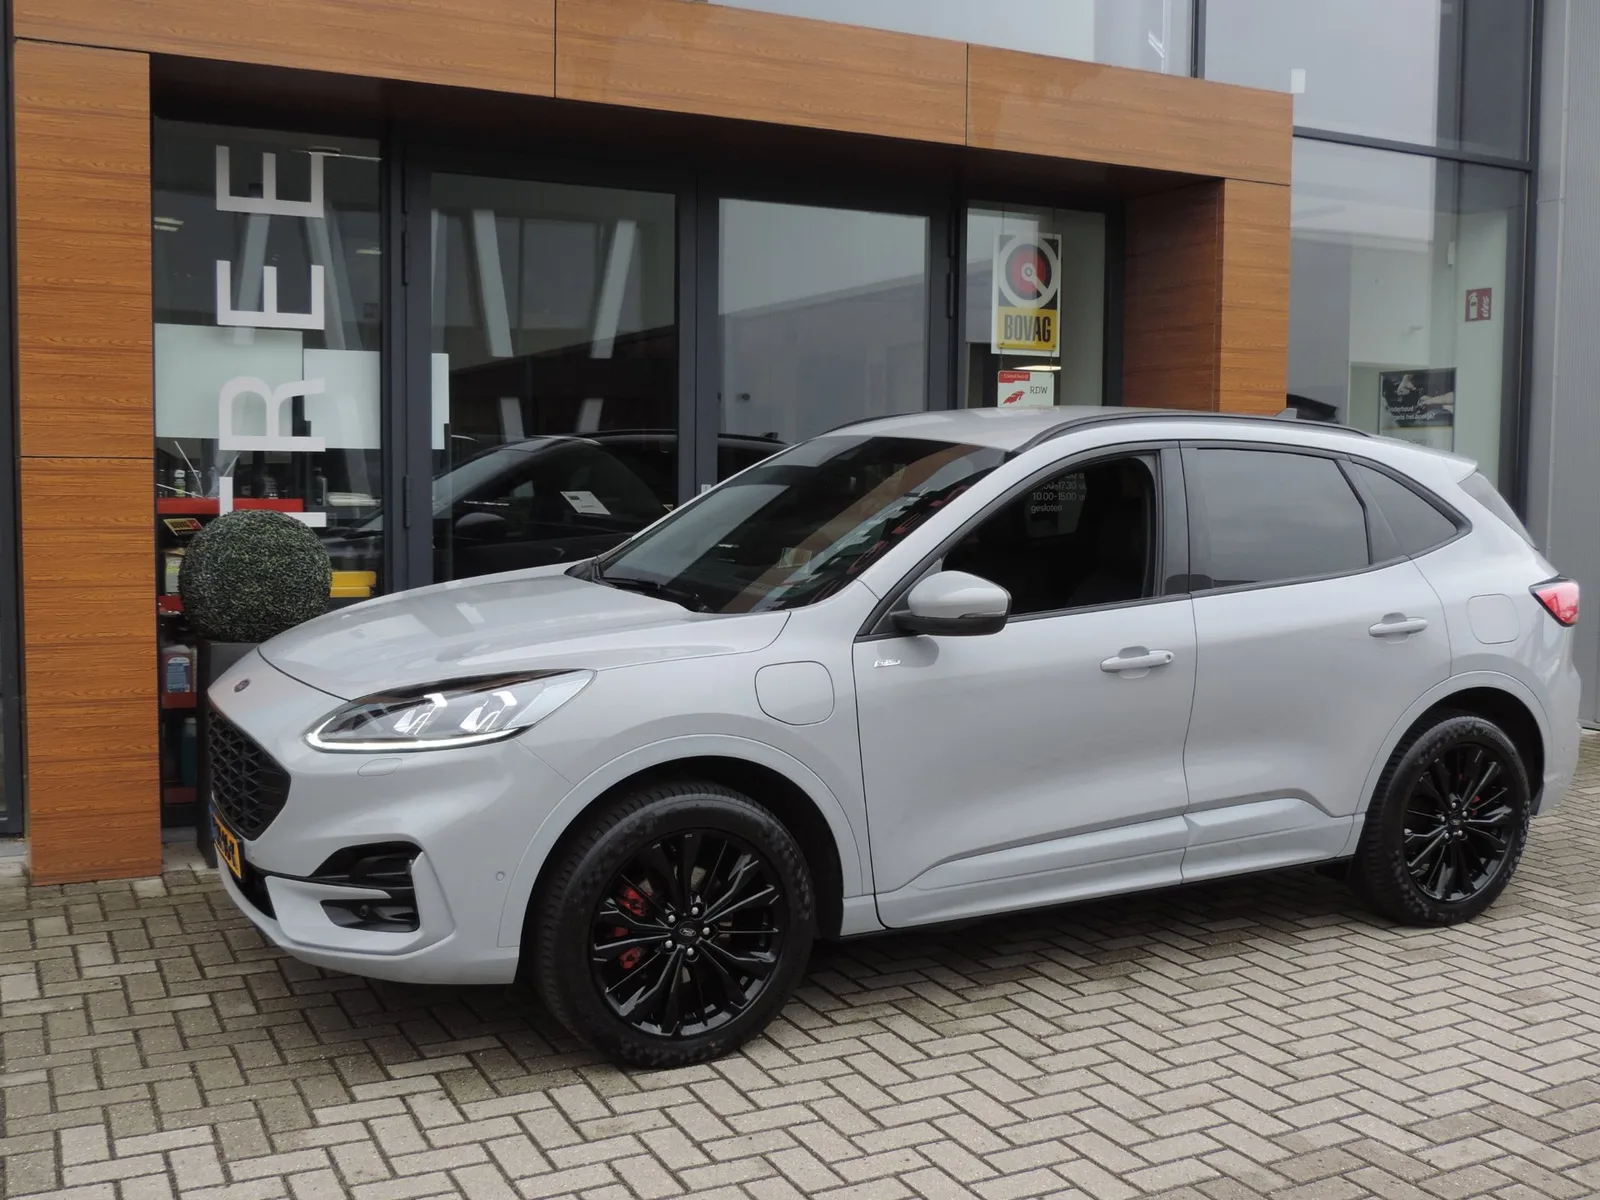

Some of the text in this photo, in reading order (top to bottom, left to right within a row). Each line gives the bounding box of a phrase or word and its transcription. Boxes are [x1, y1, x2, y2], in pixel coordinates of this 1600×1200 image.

[1004, 314, 1051, 343] BOVAG
[1030, 386, 1048, 394] RDW
[1030, 503, 1063, 514] gesloten
